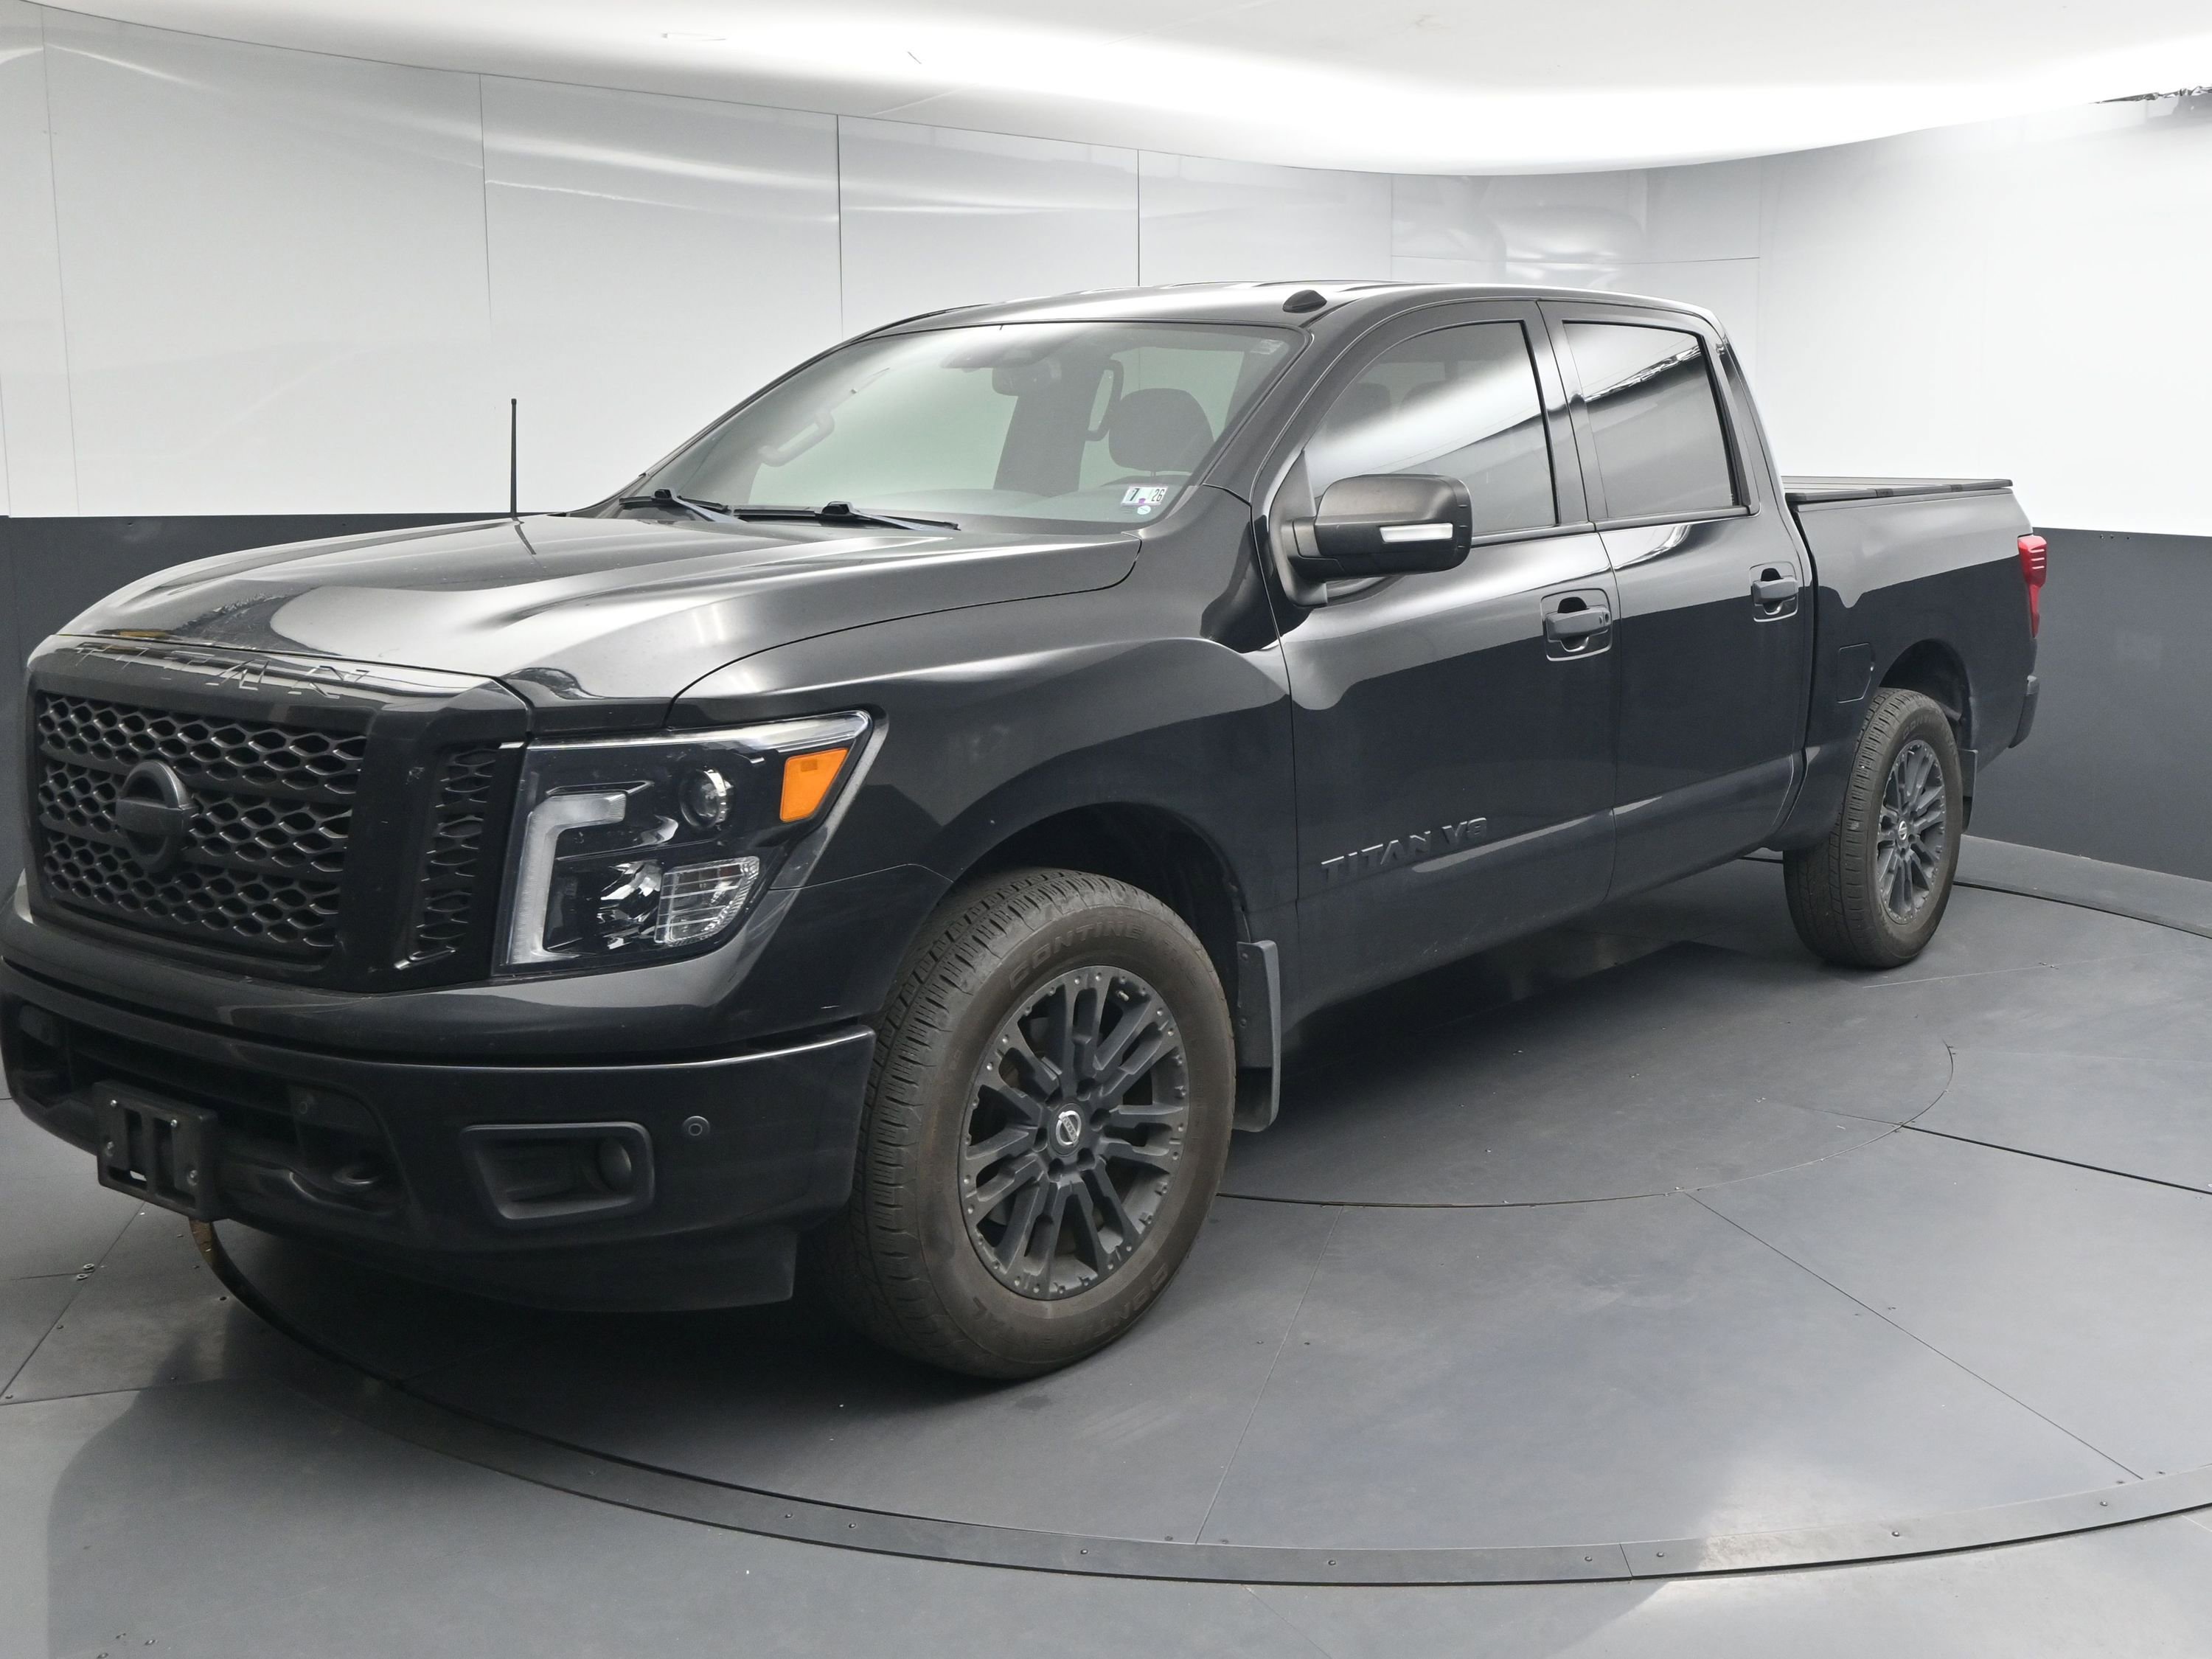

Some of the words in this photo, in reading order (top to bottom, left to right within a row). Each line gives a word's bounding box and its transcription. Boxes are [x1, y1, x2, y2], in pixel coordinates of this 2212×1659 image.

[1151, 489, 1164, 502] 26
[1321, 830, 1431, 884] TITAN
[1441, 817, 1486, 846] V8
